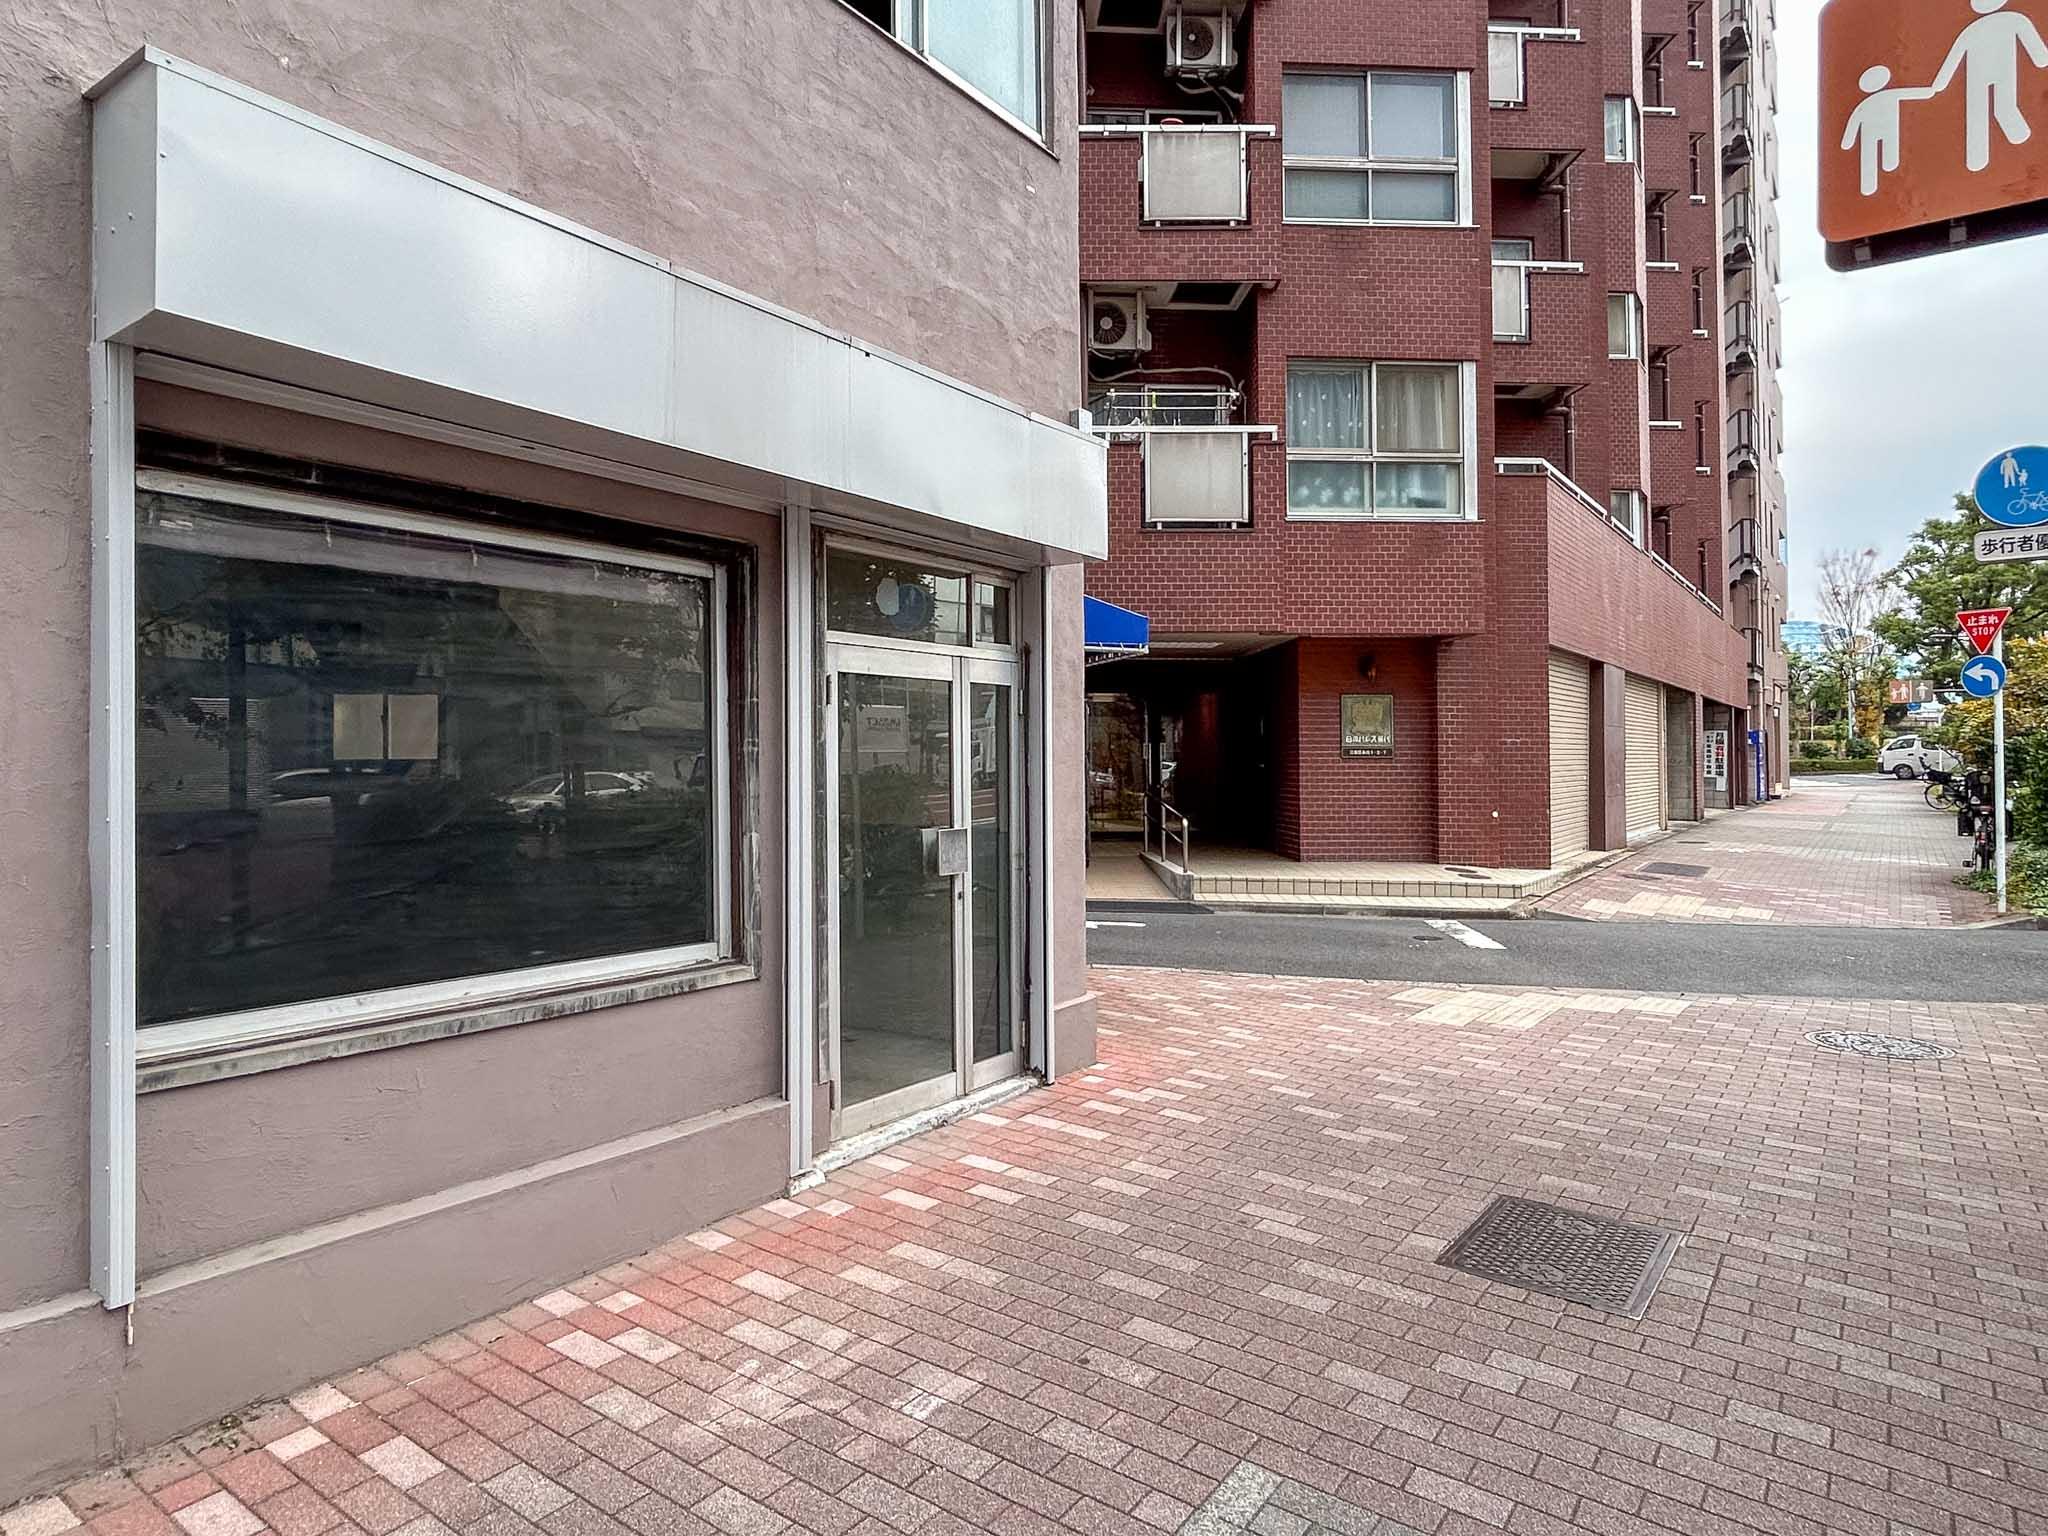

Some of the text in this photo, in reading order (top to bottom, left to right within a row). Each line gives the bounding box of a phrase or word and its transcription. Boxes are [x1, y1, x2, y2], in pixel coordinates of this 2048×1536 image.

[1981, 534, 2048, 556] 歩行者優
[1966, 614, 1999, 627] 止まれ
[1972, 627, 1995, 636] STOP
